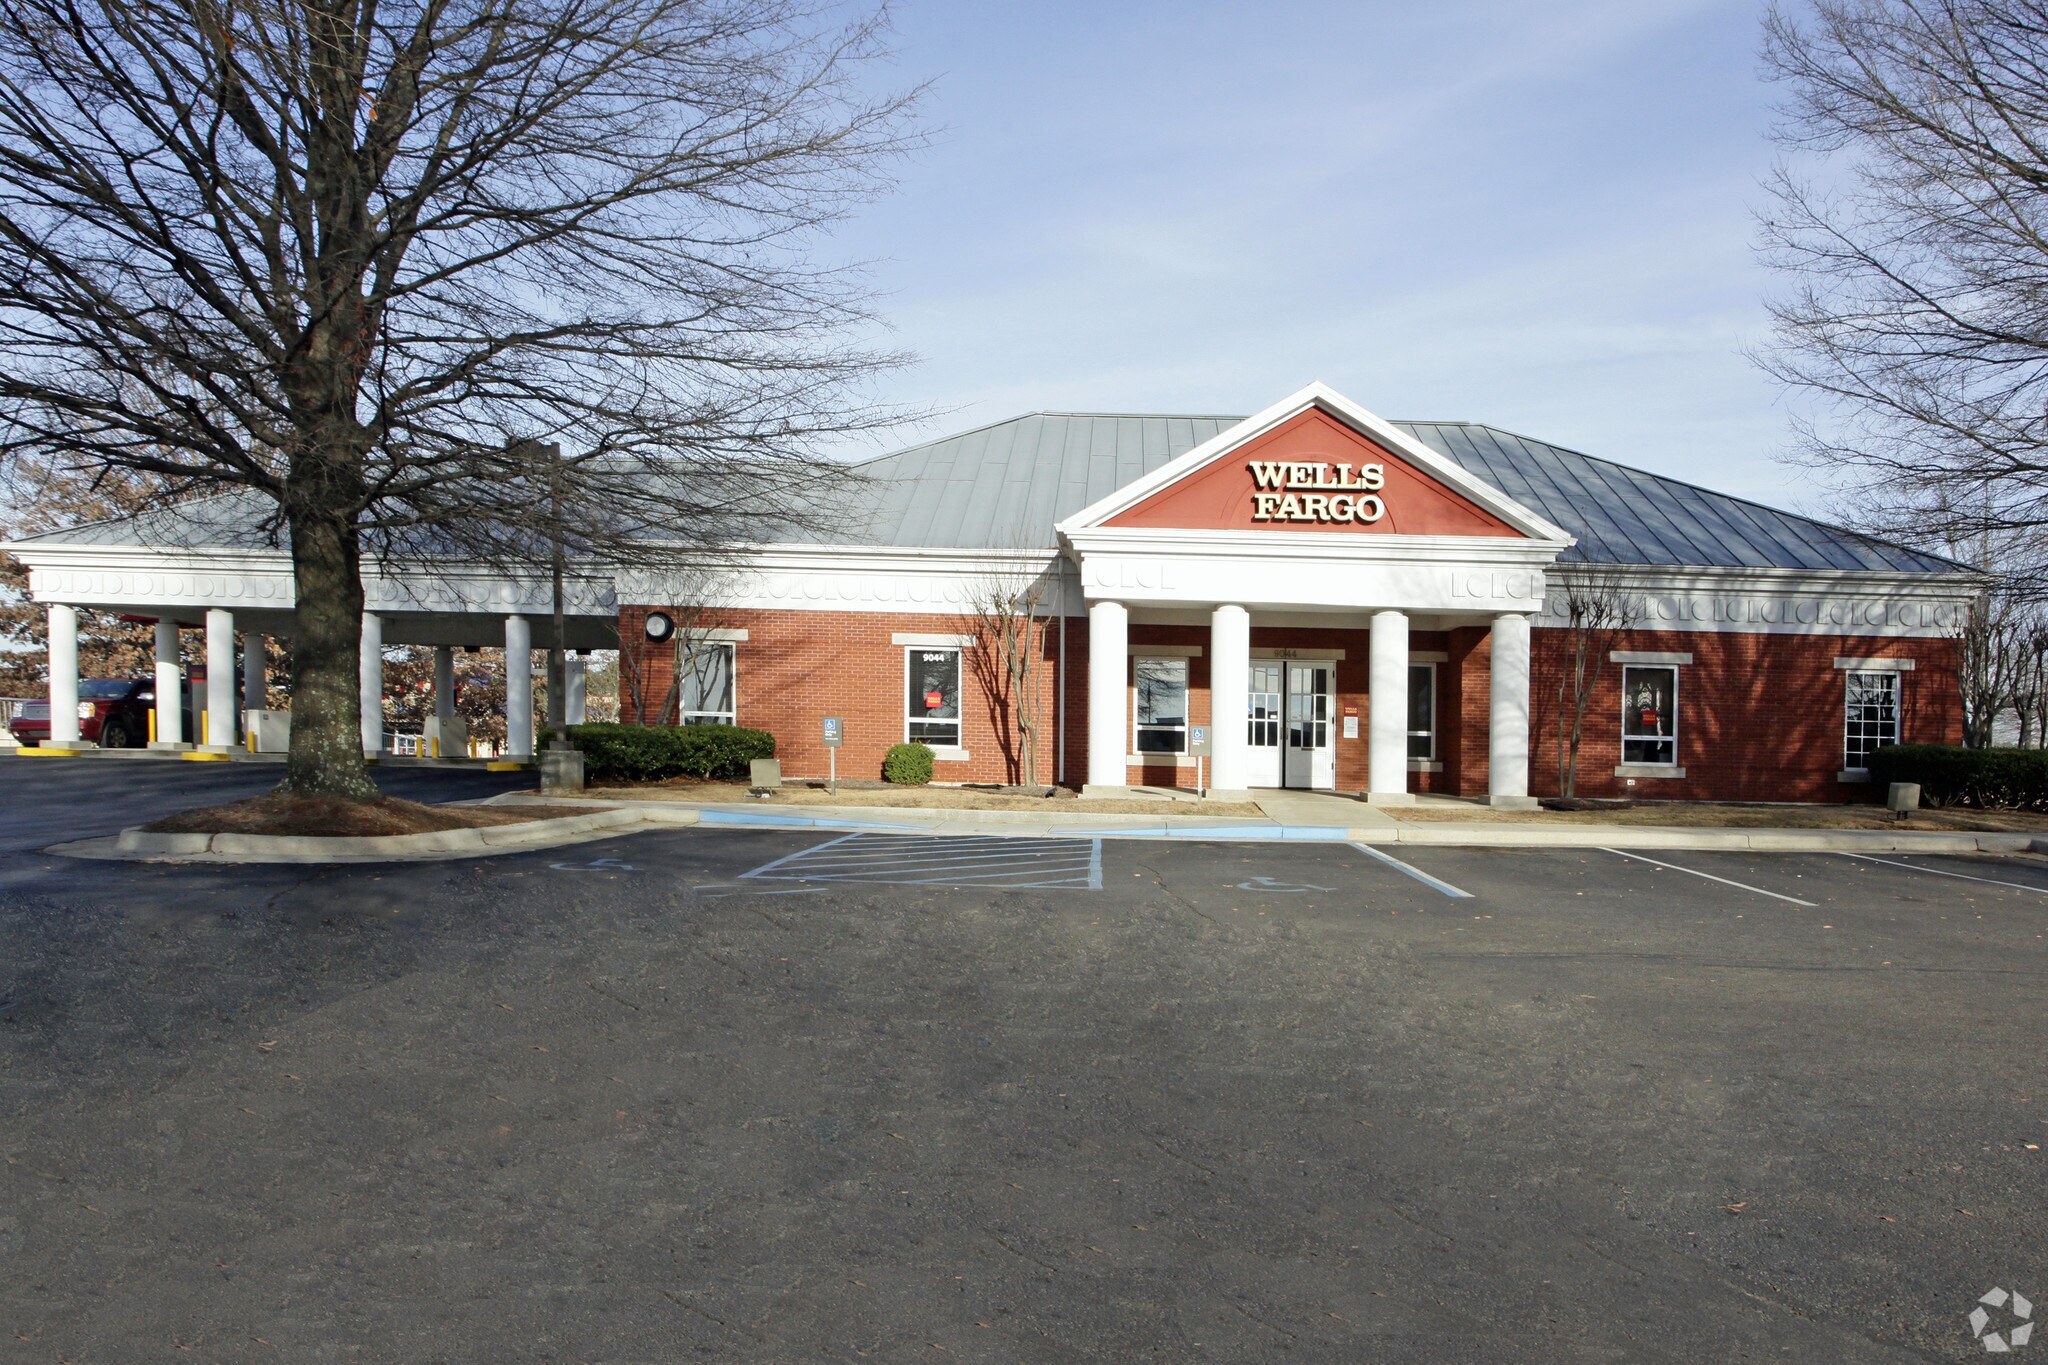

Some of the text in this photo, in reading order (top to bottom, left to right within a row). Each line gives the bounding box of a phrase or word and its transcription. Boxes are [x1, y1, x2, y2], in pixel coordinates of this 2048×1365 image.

[1248, 461, 1385, 490] WELLS
[1254, 493, 1385, 522] FARGO
[923, 653, 944, 661] 9044
[1273, 649, 1297, 658] 9044
